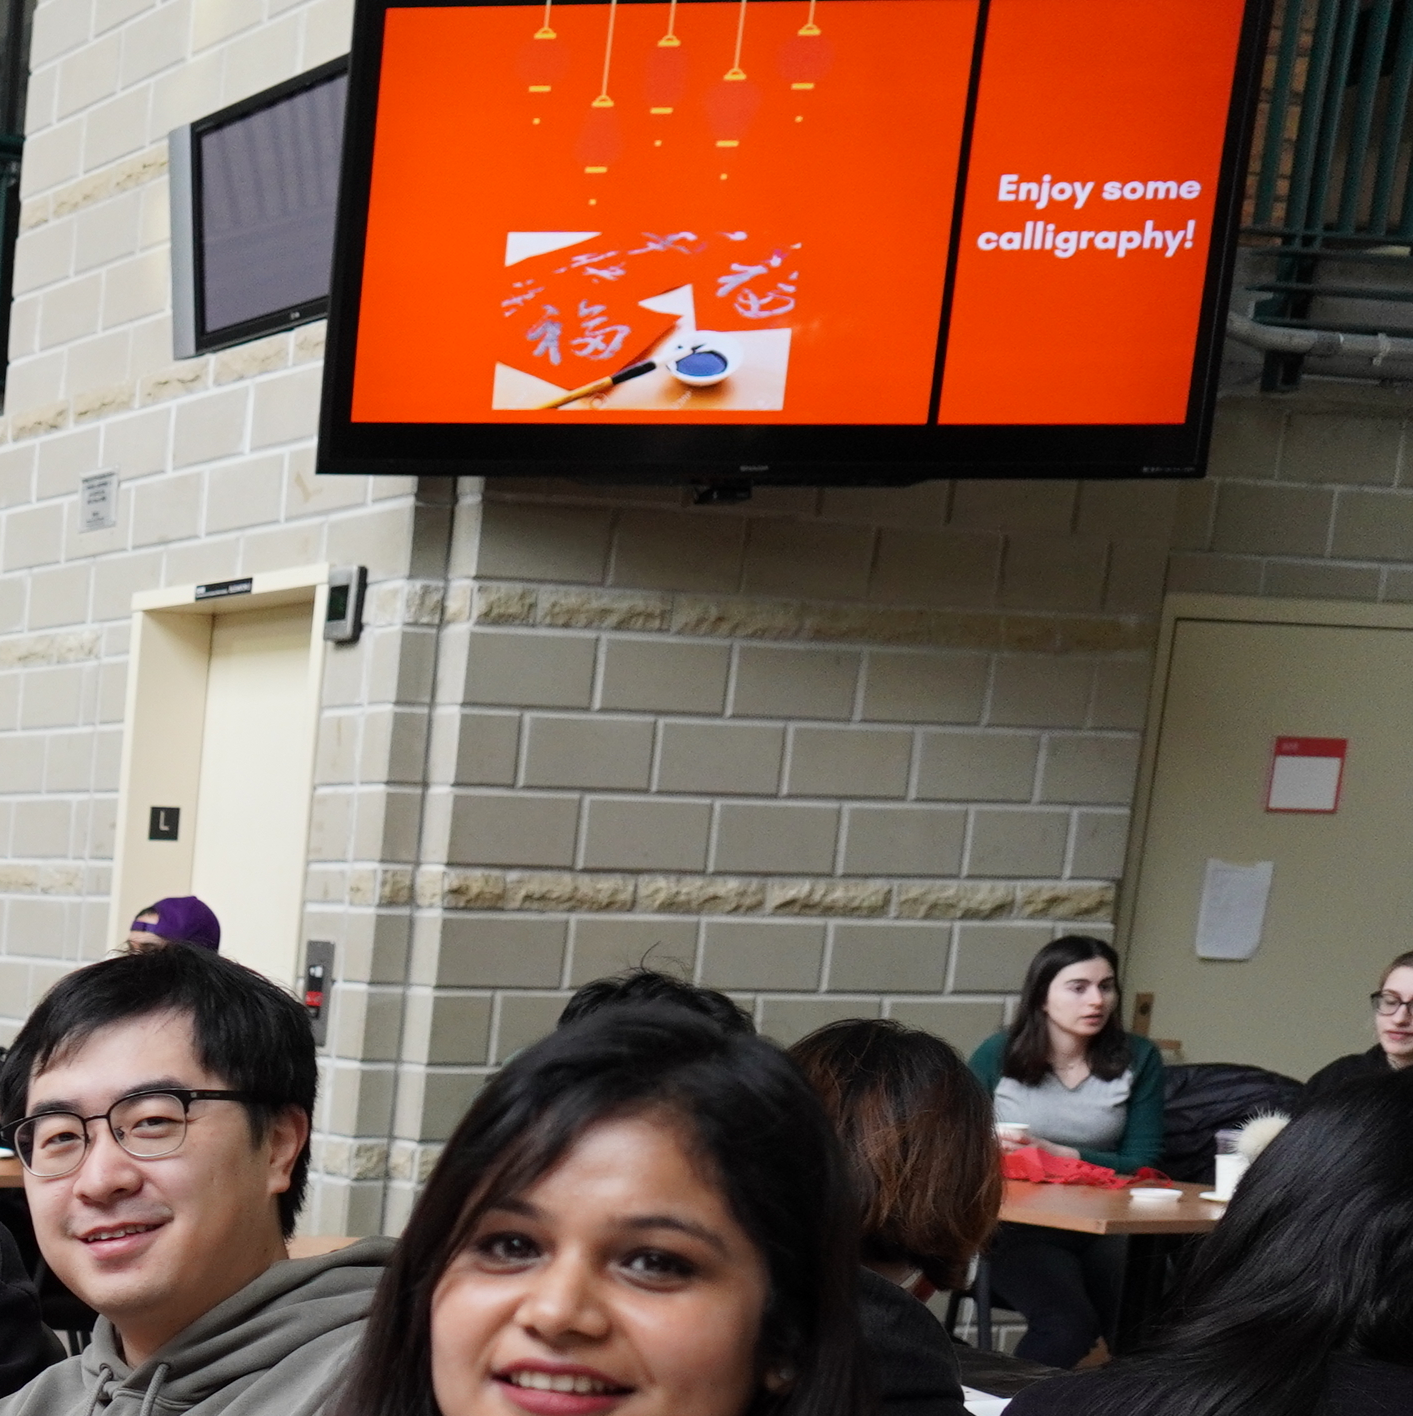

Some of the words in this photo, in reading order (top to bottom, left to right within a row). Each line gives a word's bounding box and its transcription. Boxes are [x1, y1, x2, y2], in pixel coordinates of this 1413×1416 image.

[998, 173, 1095, 210] Enjoy
[1102, 180, 1202, 201] some
[977, 219, 1196, 258] calligraphy!
[159, 810, 170, 831] L
